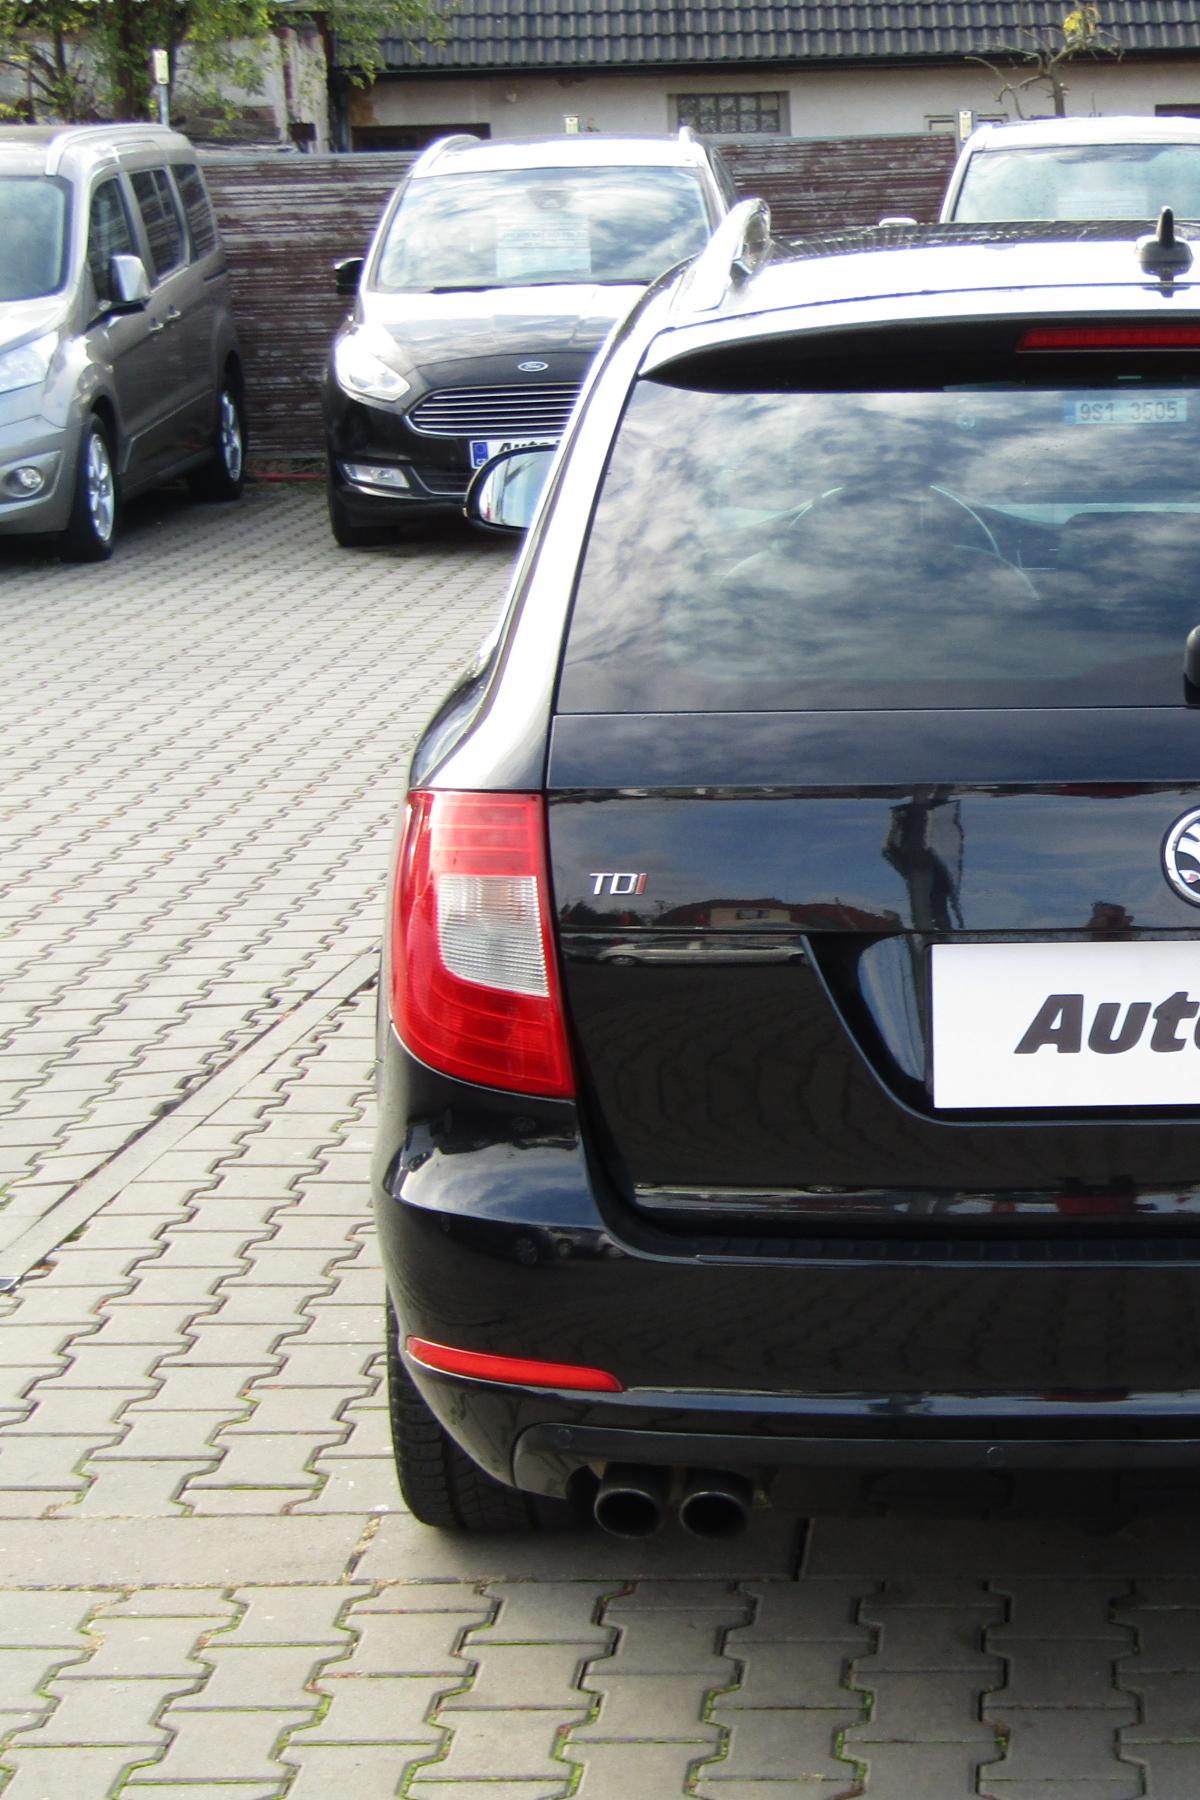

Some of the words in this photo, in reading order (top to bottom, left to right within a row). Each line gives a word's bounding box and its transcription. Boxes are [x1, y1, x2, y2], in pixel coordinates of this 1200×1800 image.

[1080, 402, 1114, 421] 9S1
[1130, 401, 1178, 420] 3505
[589, 872, 648, 895] TDI
